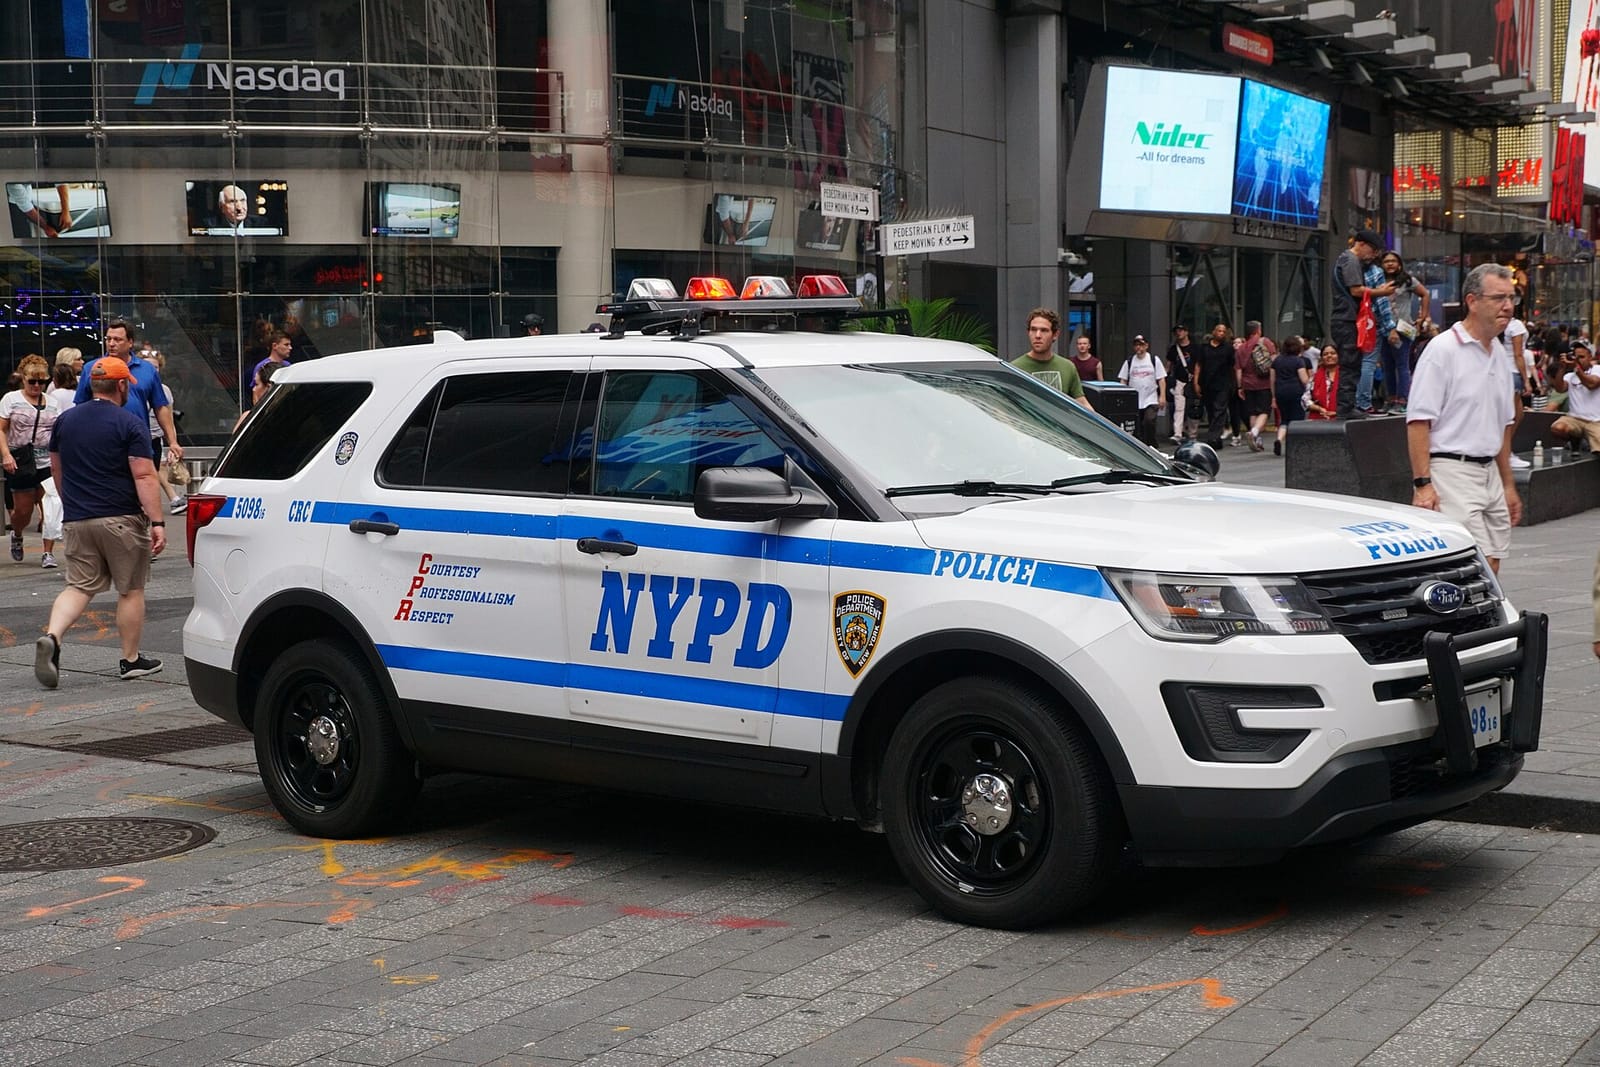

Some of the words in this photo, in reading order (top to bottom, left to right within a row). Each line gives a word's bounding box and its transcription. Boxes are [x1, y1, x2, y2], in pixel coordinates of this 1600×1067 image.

[206, 63, 345, 101] Nasdaq
[678, 88, 734, 121] Nasdaq
[1131, 121, 1214, 150] Nidec
[1156, 152, 1169, 163] for
[1171, 153, 1205, 165] dreams
[823, 187, 848, 200] PEDESTRIAN
[848, 190, 859, 201] FLOW
[859, 192, 869, 203] ZONE
[823, 201, 834, 212] KEEP
[834, 202, 850, 214] MOVING
[893, 223, 932, 238] PEDESTRIAN
[933, 222, 951, 234] FLOW
[952, 220, 969, 232] ZONE
[893, 239, 910, 250] KEEP
[911, 237, 936, 249] MOVING
[288, 500, 312, 522] CRC
[1340, 520, 1410, 536] NYPD
[1360, 530, 1448, 560] POLICE
[935, 550, 1035, 586] POLICE
[836, 603, 883, 620] DEPARTMENT
[846, 594, 876, 607] POLICE
[589, 570, 793, 670] NYPD
[835, 627, 845, 648] CITY
[841, 649, 851, 661] OF
[858, 648, 871, 667] NEW
[868, 624, 881, 647] YORK
